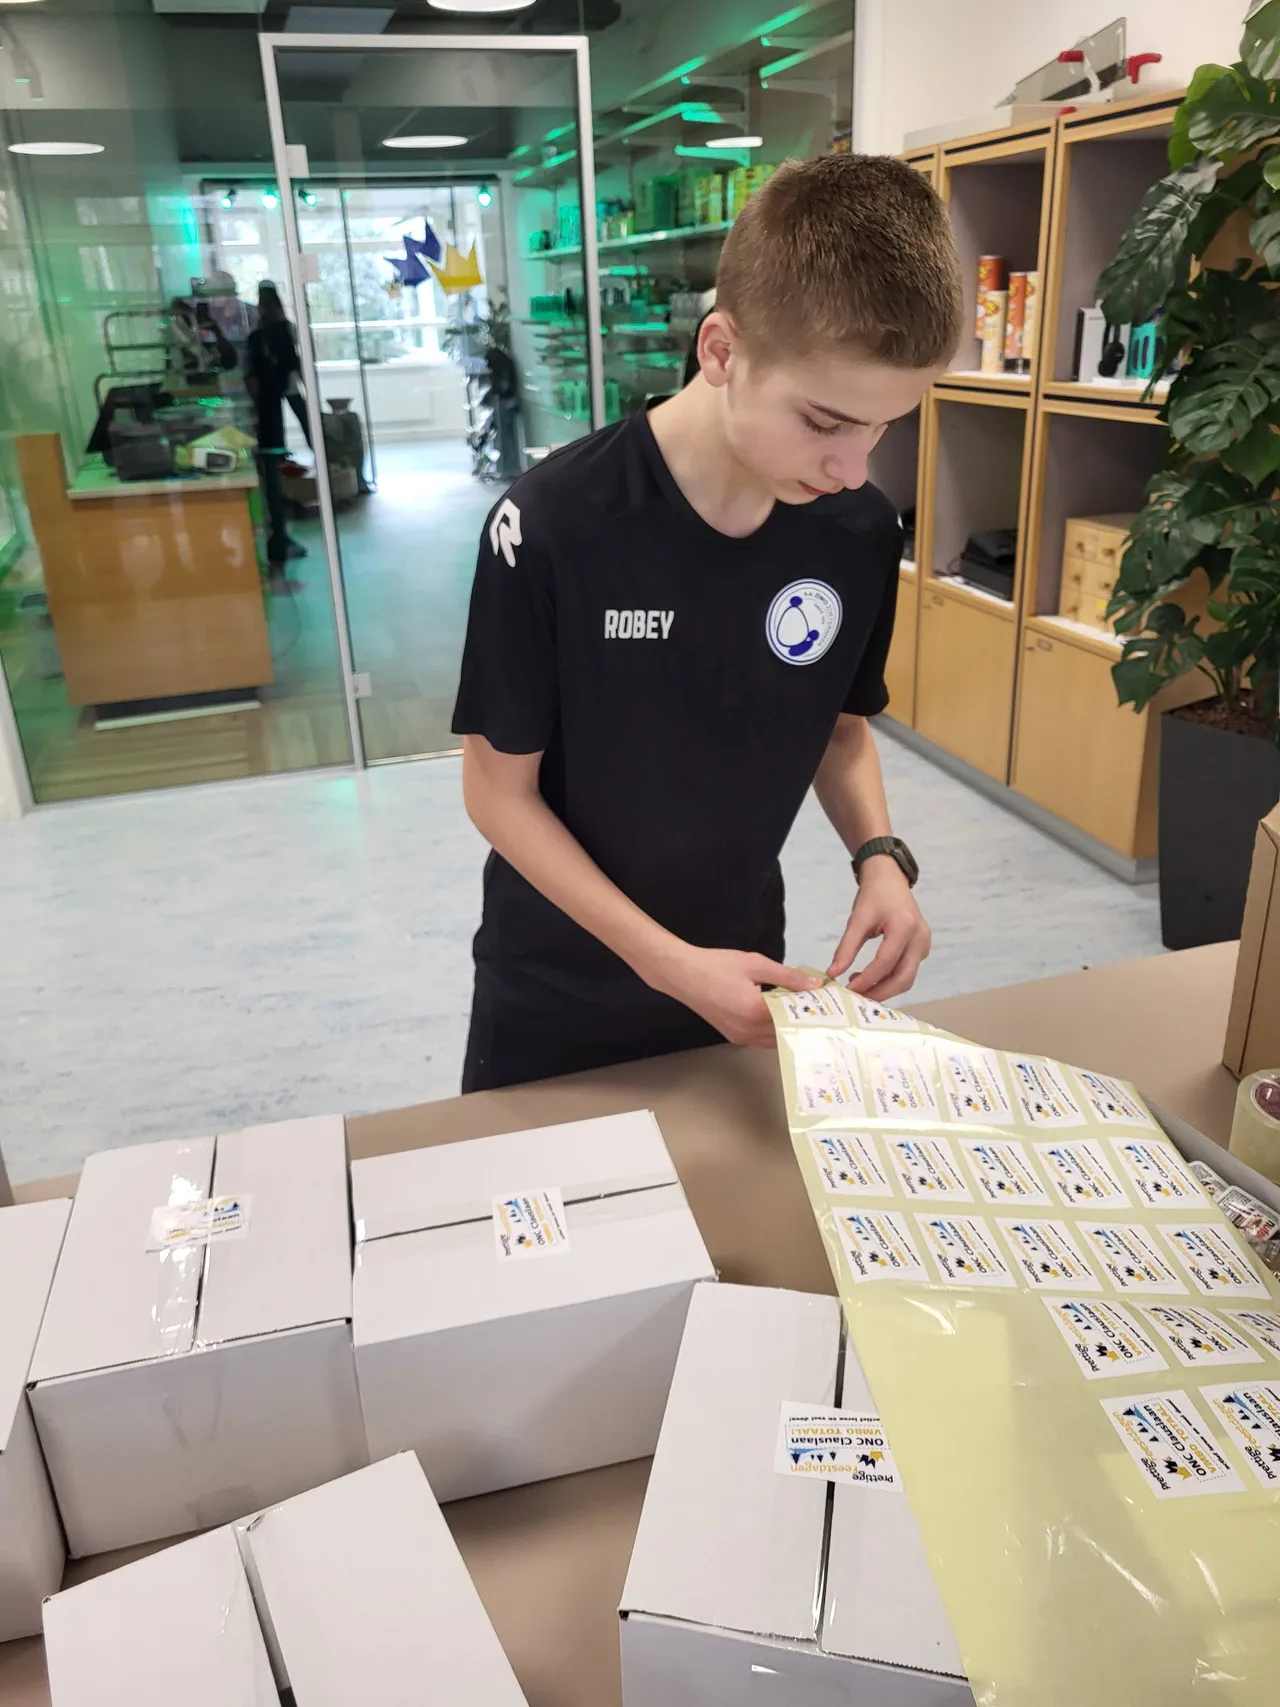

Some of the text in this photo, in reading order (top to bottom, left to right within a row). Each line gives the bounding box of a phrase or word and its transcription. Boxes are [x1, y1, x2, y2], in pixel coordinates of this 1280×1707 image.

[604, 610, 674, 640] ROBEY
[864, 1217, 900, 1267] ONC Clauslaan
[947, 1222, 986, 1273] ONC Clauslaan
[1028, 1226, 1058, 1259] Clauslaan
[1109, 1230, 1141, 1263] Clauslaan
[1190, 1231, 1224, 1265] Clauslaan
[1055, 1262, 1072, 1277] ONC
[1139, 1266, 1157, 1281] ONC
[1222, 1267, 1240, 1283] ONC
[1080, 1303, 1115, 1338] Clauslaan
[1072, 1342, 1101, 1372] Prettige
[1113, 1339, 1134, 1358] ONC
[1166, 1335, 1198, 1359] Prettige
[1206, 1336, 1230, 1352] ONC
[792, 1428, 882, 1436] VMBO TOTAAL!
[1212, 1398, 1262, 1449] Feestdagen
[1243, 1392, 1280, 1440] lauslaan
[791, 1436, 884, 1446] ONC Clauslaan
[1112, 1411, 1156, 1462] Feestdagen
[1143, 1405, 1205, 1476] ONC Clauslaan
[1152, 1402, 1216, 1473] VMBO TOTAAL!
[790, 1461, 858, 1474] Feestdagen
[852, 1471, 894, 1483] Prettige
[1140, 1457, 1171, 1490] Prettige
[1244, 1445, 1278, 1480] Prettige
